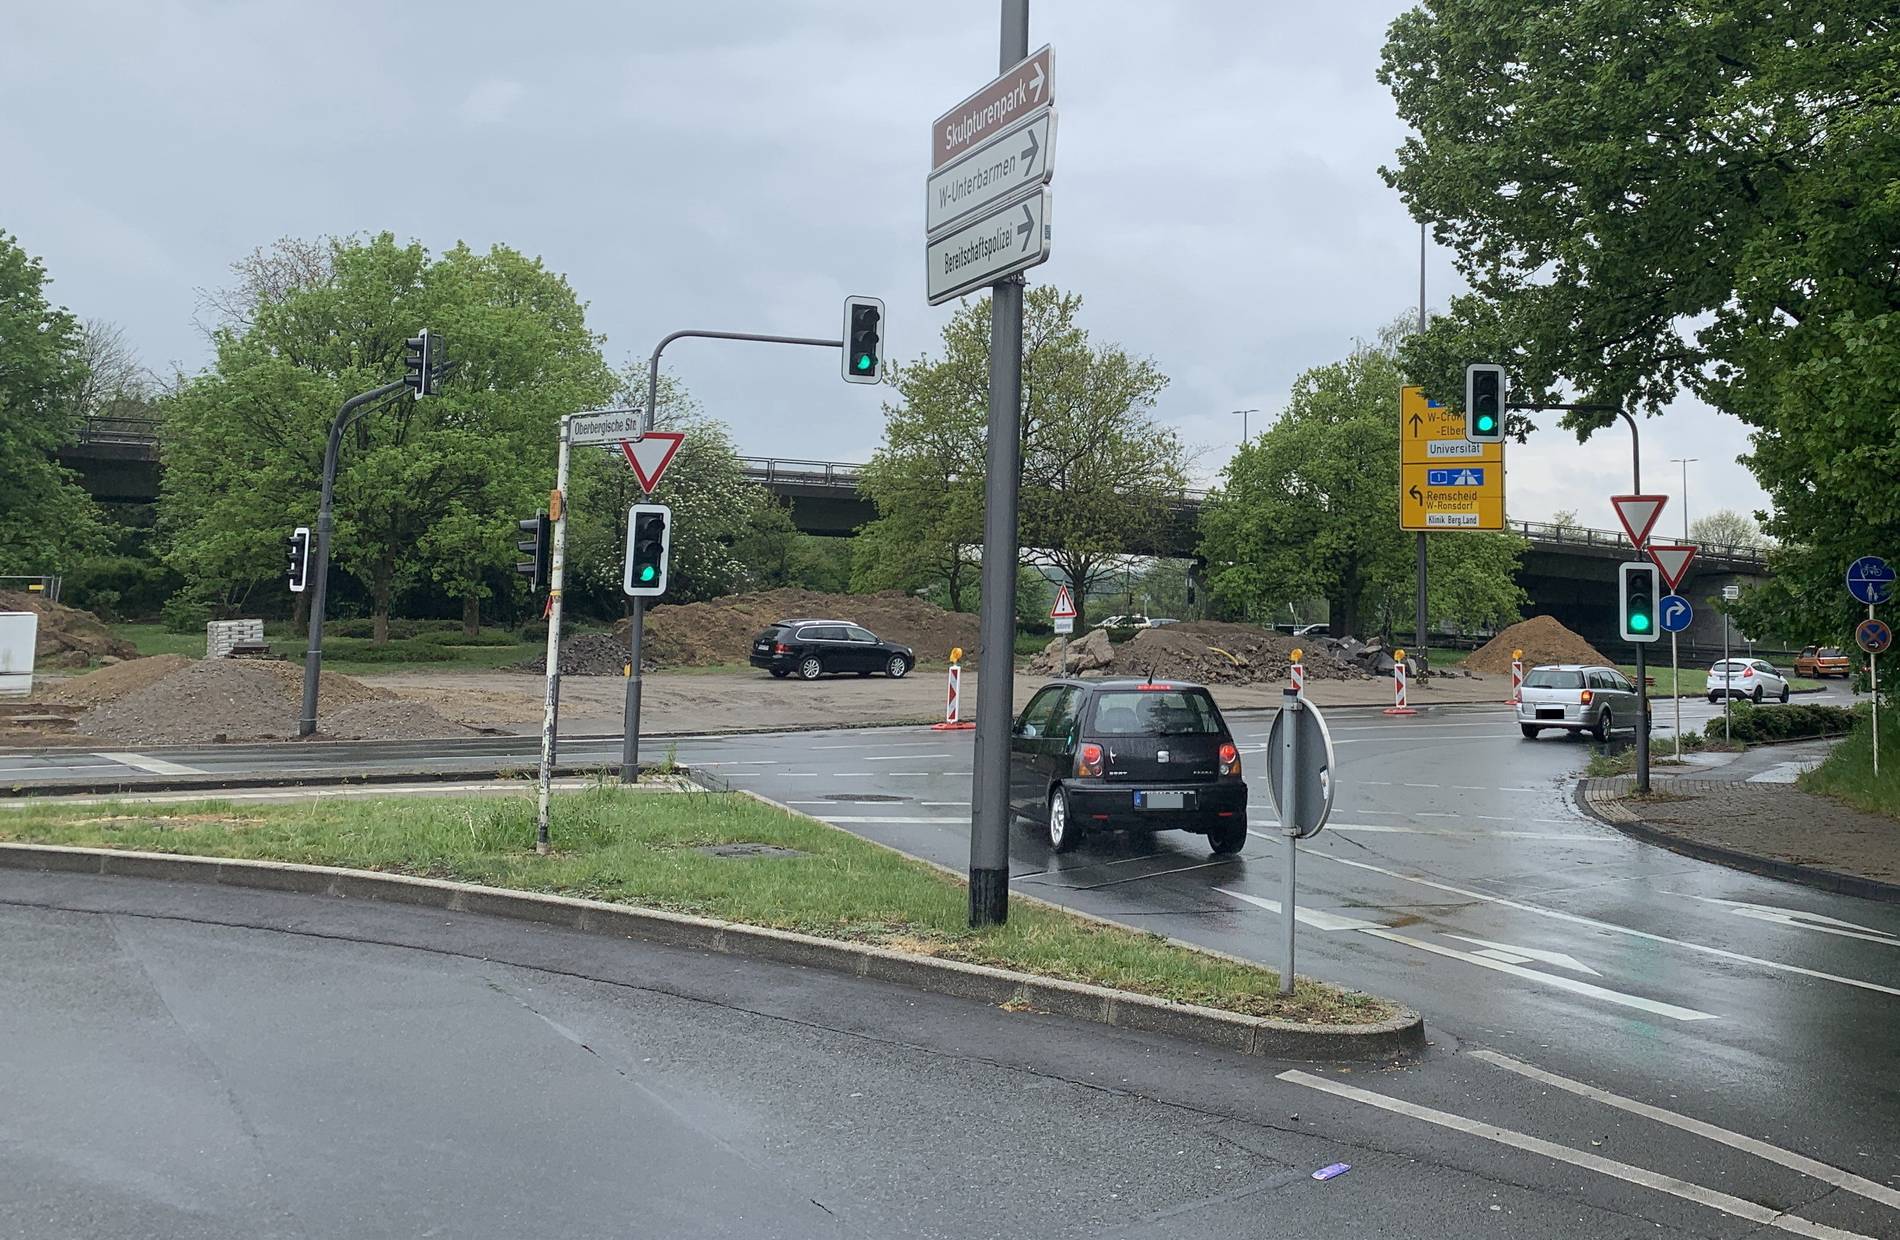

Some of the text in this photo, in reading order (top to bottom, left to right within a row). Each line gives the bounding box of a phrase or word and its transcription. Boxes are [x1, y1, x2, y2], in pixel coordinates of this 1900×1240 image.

[945, 78, 1026, 150] Skulpturenpark
[939, 155, 1015, 208] W-Unterbarmen
[944, 222, 1012, 274] Bereitschaftspolizei
[575, 420, 623, 436] Oberbergische
[1427, 490, 1477, 501] Remscheid
[1427, 501, 1473, 510] W-Ronsdorf
[1428, 515, 1445, 525] Klinik
